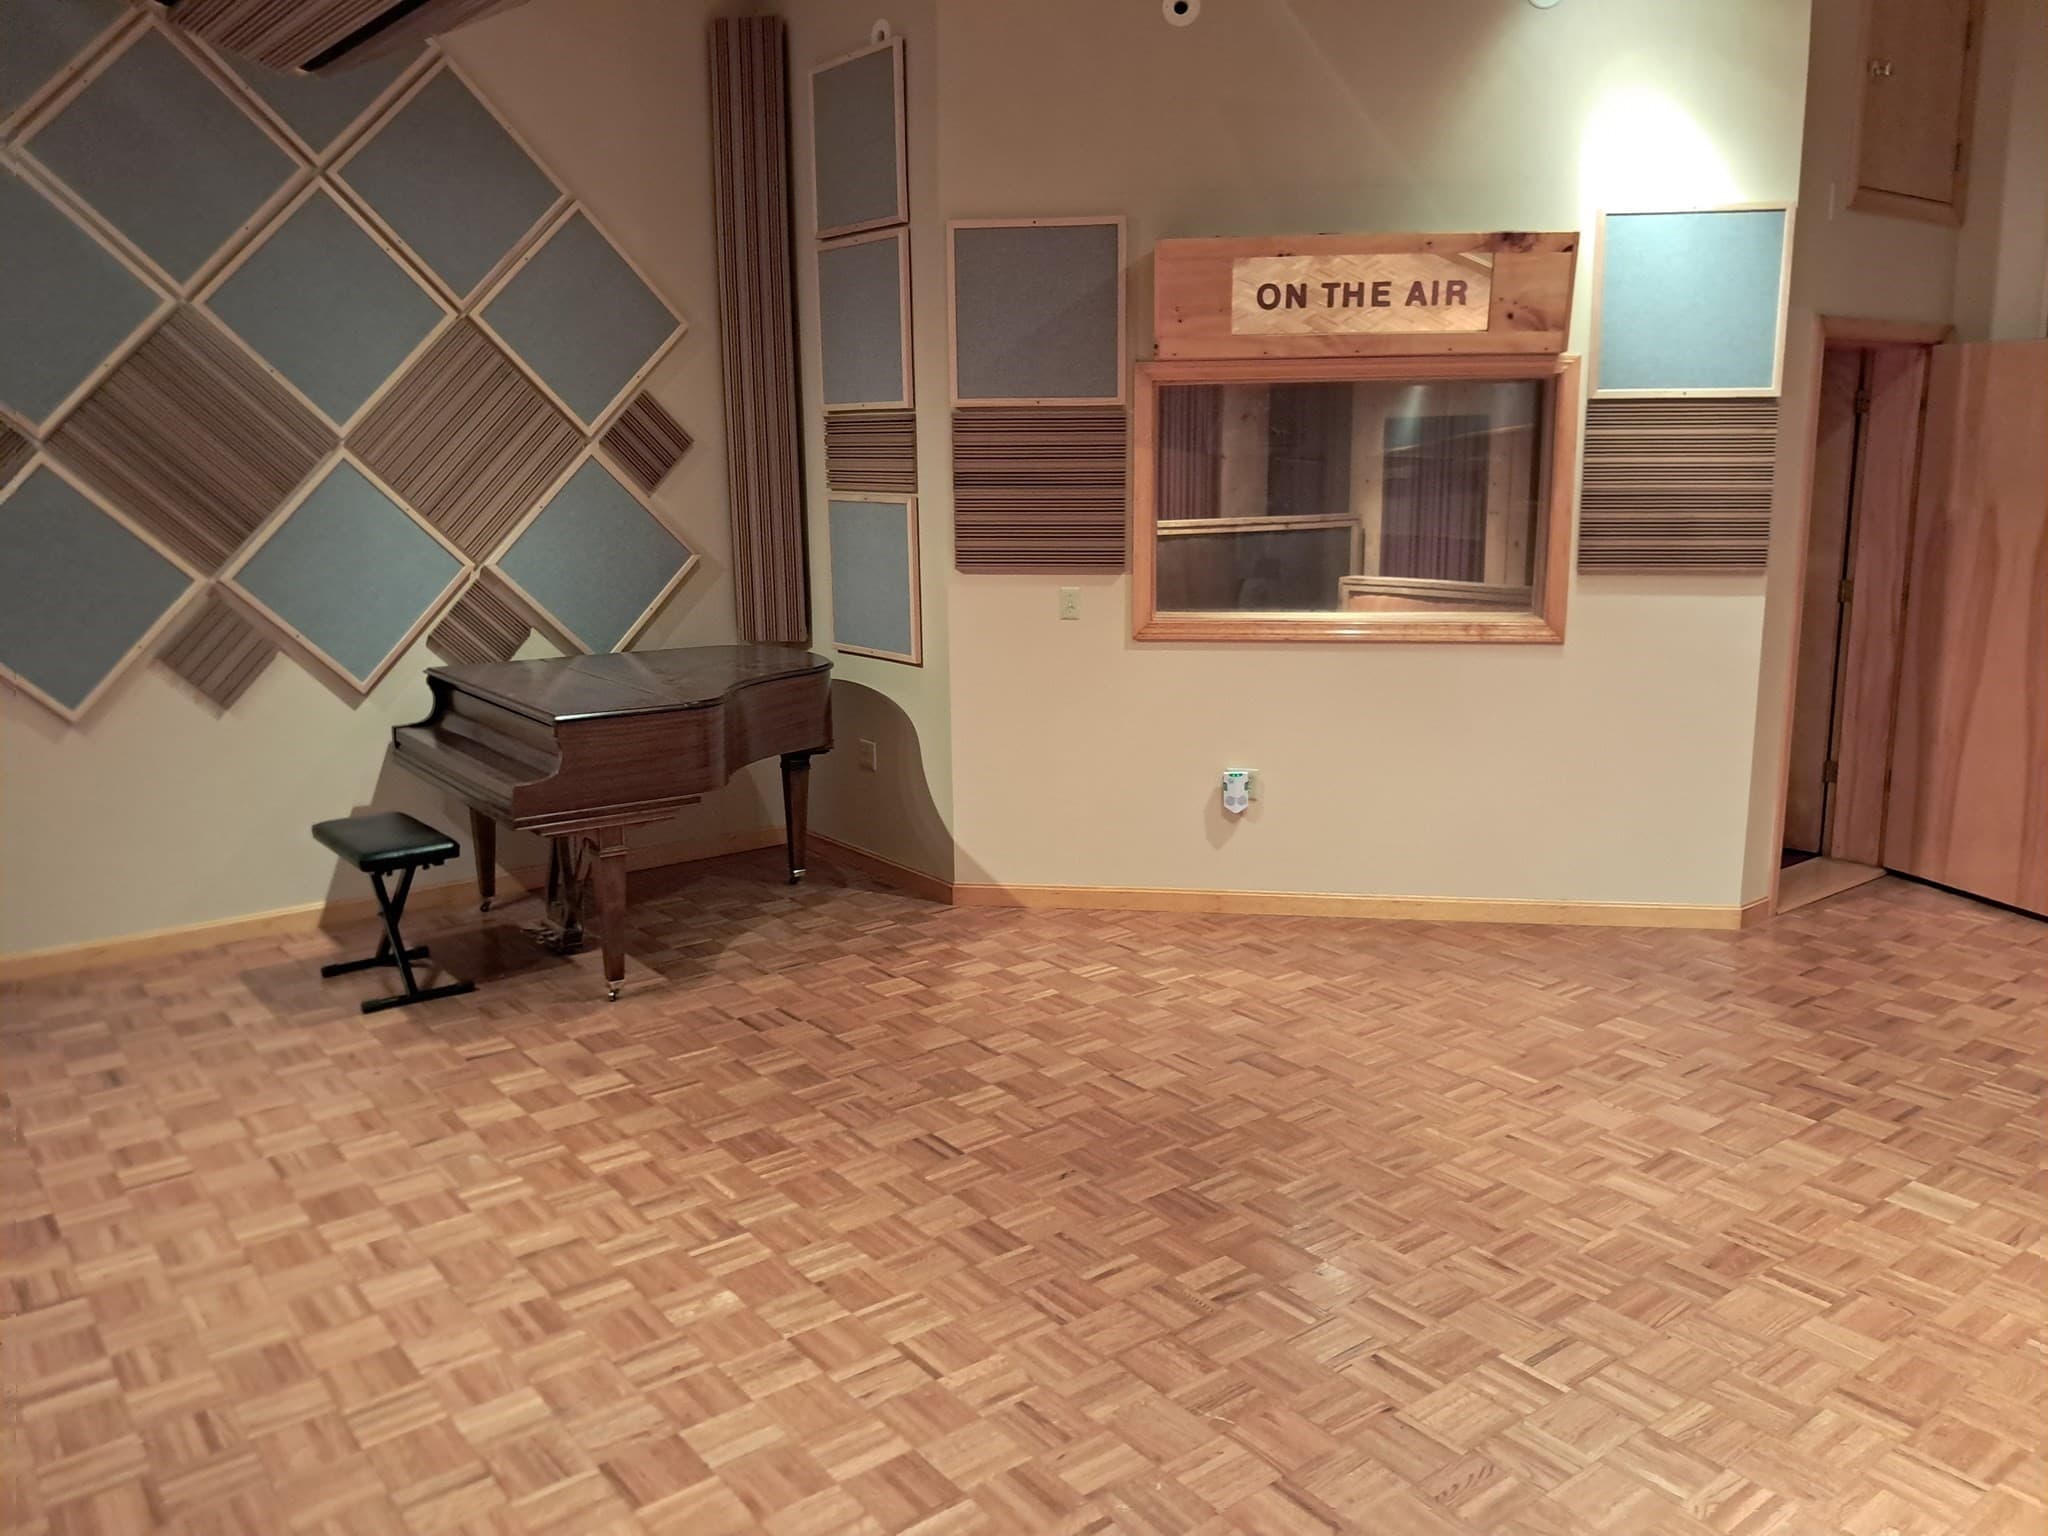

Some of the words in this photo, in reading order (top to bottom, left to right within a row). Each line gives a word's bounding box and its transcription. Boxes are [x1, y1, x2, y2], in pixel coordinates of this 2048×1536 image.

[1256, 282, 1308, 310] ON
[1321, 281, 1392, 308] THE
[1404, 280, 1468, 307] AIR
